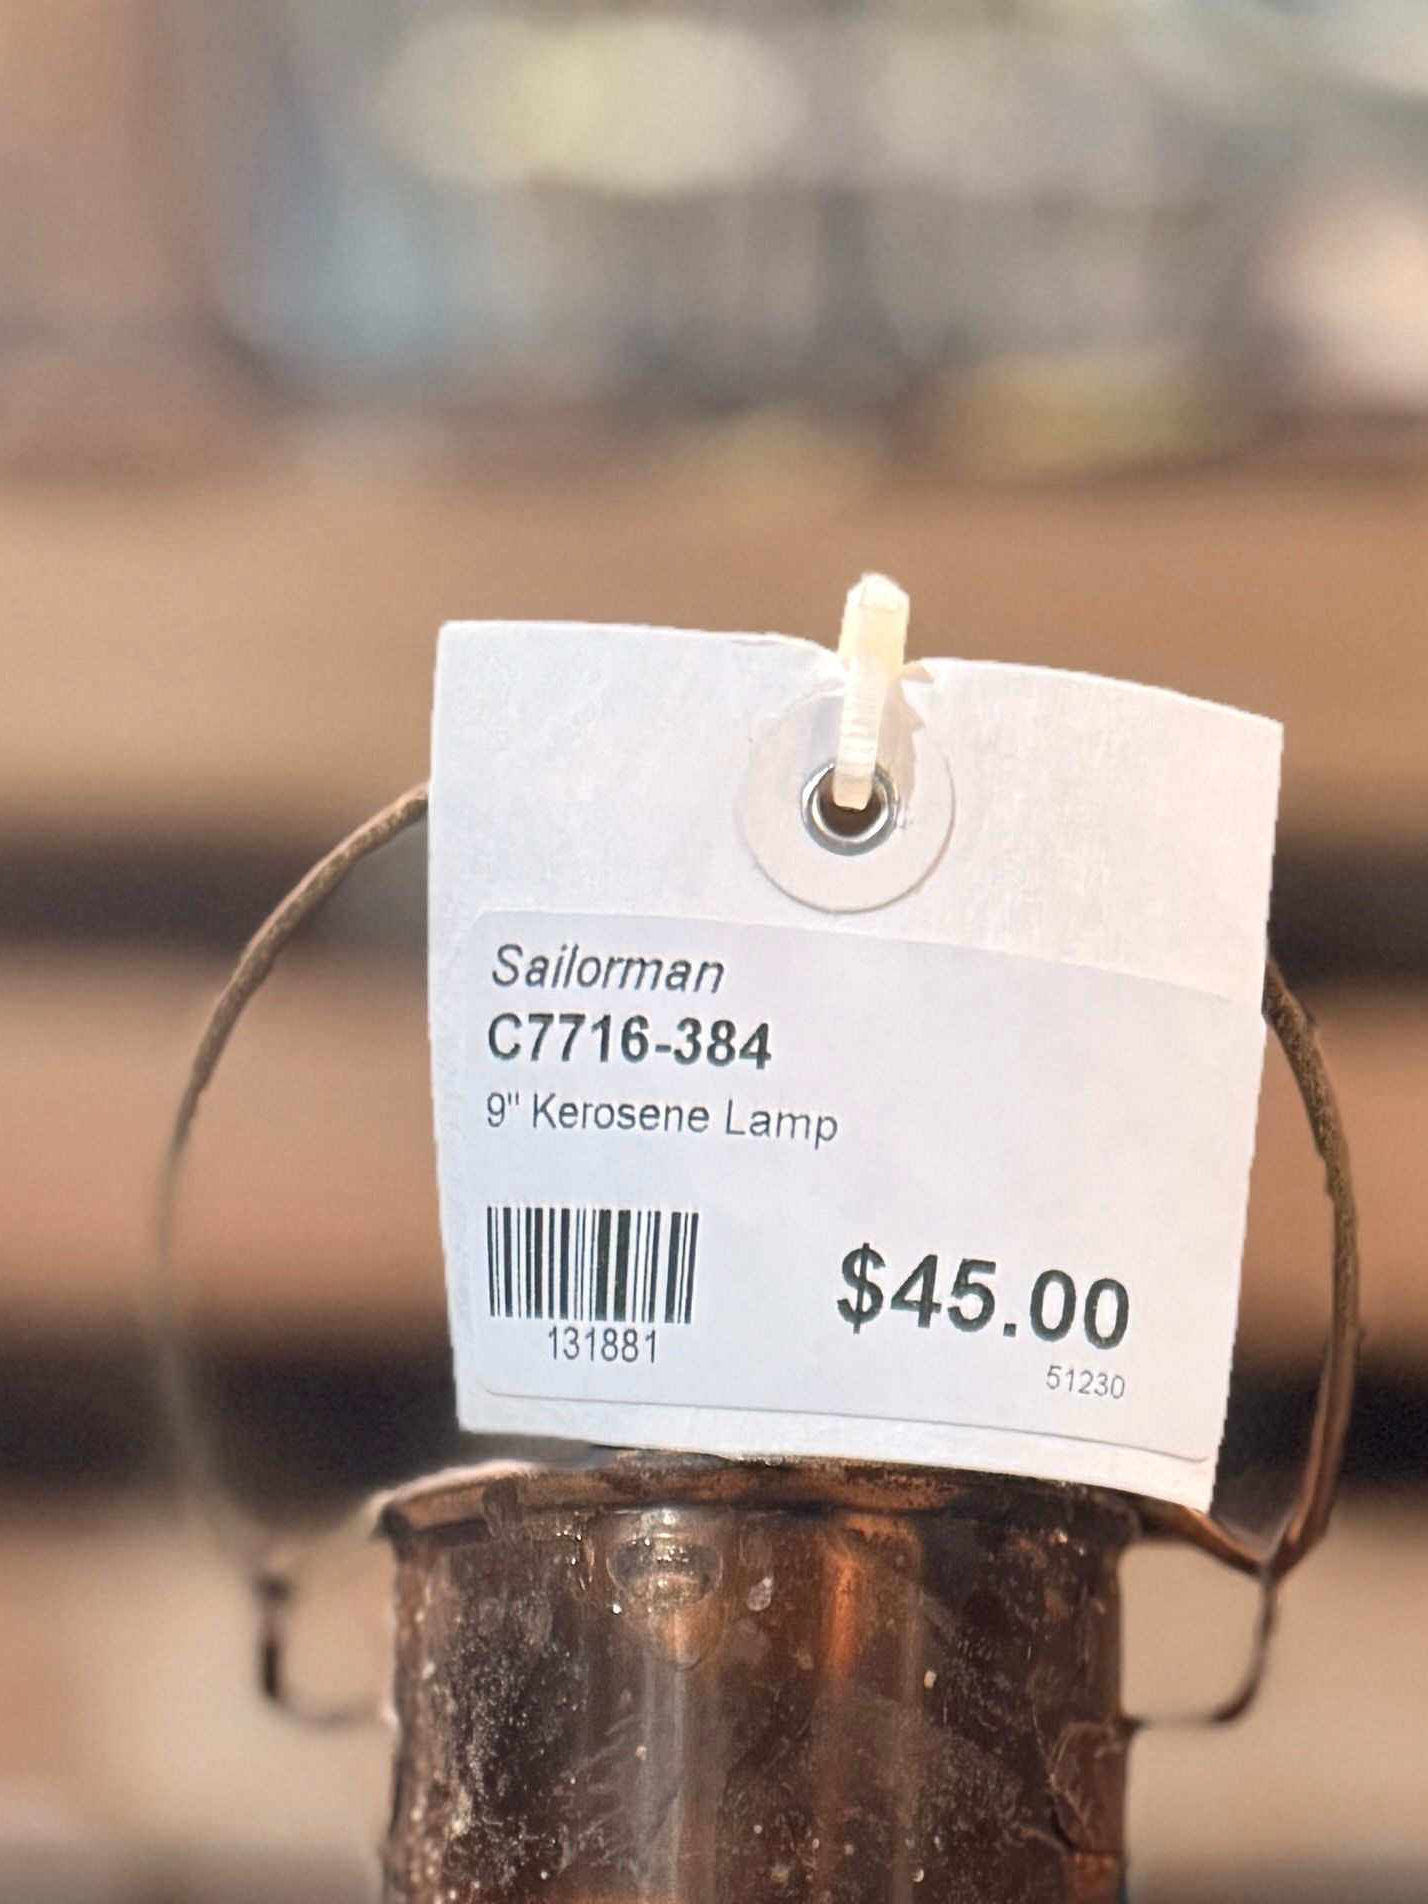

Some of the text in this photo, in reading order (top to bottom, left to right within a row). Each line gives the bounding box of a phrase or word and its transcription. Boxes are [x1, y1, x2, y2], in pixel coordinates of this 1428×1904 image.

[492, 943, 725, 996] Sailorman
[486, 1012, 773, 1072] C7716-384
[485, 1092, 840, 1150] 9" Kerosene Lamp
[836, 1242, 1130, 1351] $45.00
[547, 1327, 658, 1364] 131881
[1045, 1364, 1127, 1401] 51230
